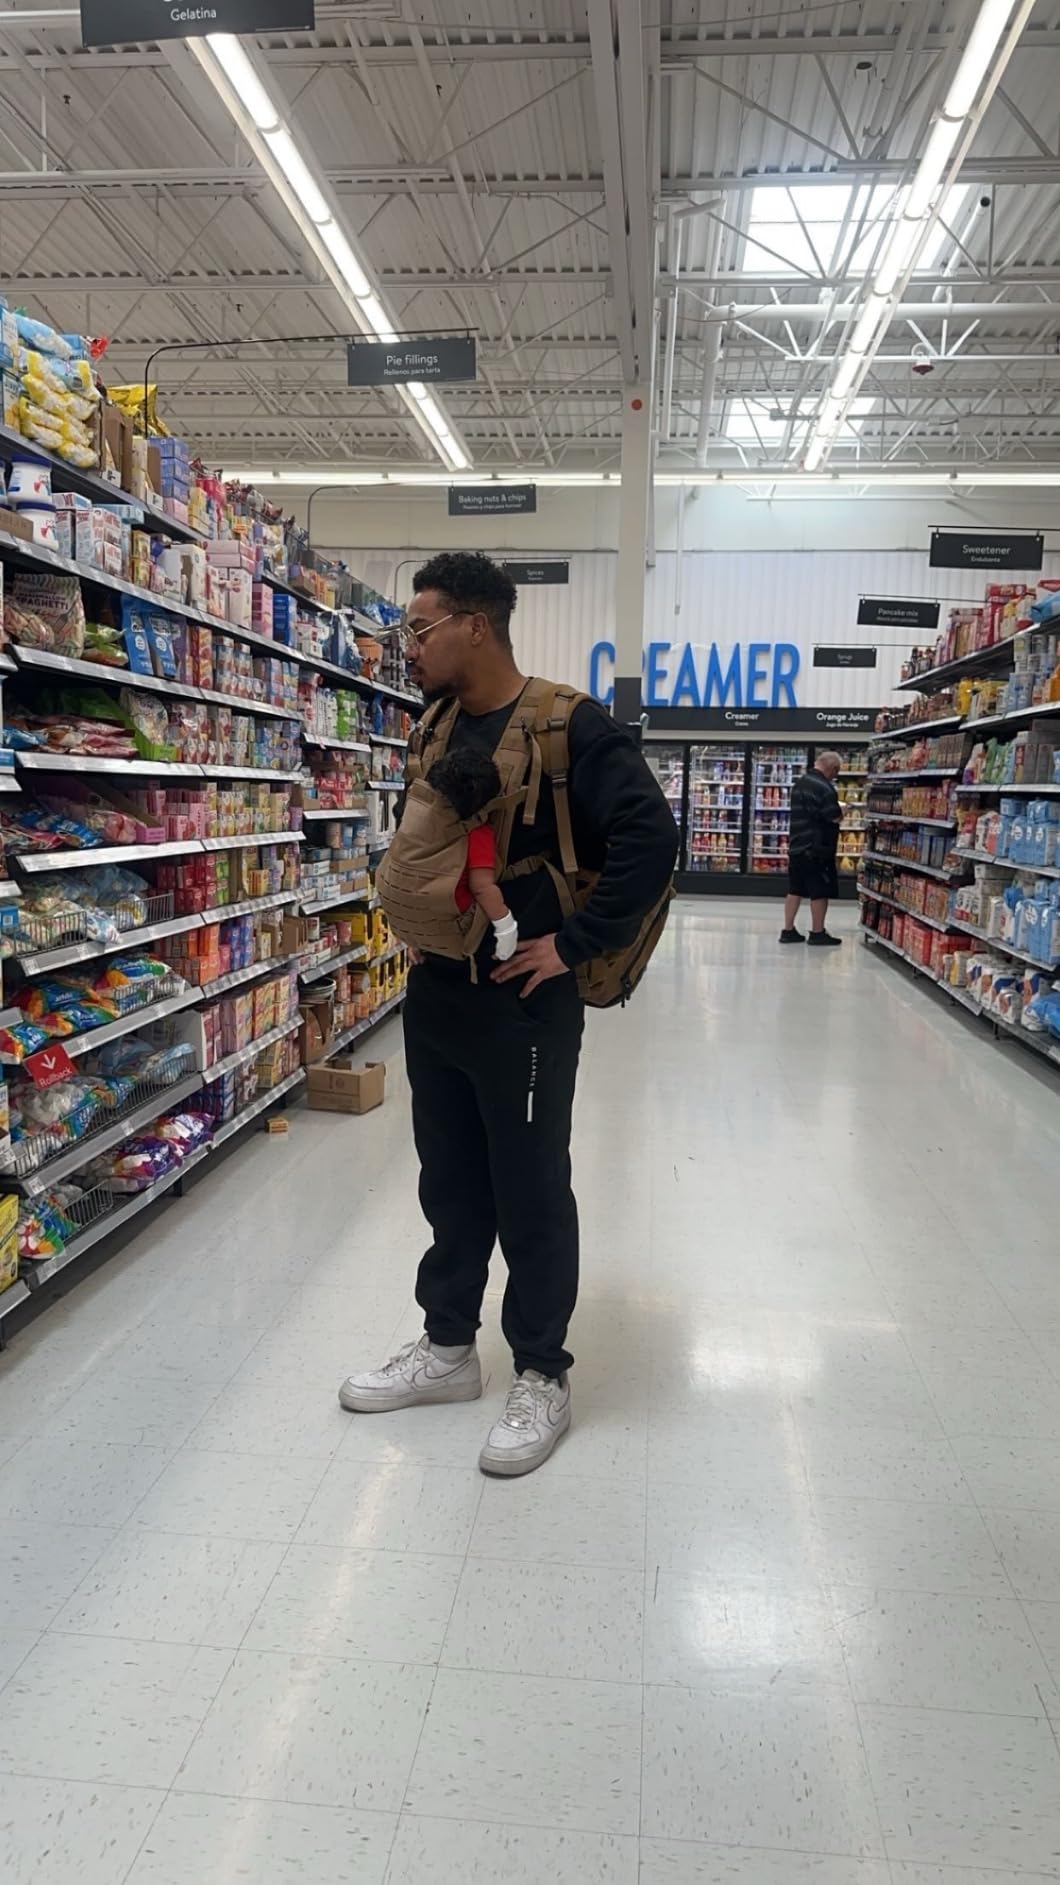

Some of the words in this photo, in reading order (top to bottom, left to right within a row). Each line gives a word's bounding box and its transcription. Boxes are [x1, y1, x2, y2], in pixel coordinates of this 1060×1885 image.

[171, 8, 217, 21] Gelatina
[386, 355, 402, 366] Pie
[405, 354, 438, 367] fillings
[384, 368, 409, 376] Rellenos
[458, 495, 482, 504] Baking
[484, 495, 499, 503] nuts
[508, 494, 526, 502] chips
[963, 545, 1010, 555] Sweetener
[878, 608, 905, 616] Pancake
[589, 641, 800, 708] CEAMER
[725, 711, 759, 720] Creamer
[816, 712, 847, 722] Orange
[848, 712, 869, 721] Juice
[39, 1066, 73, 1088] Rollback
